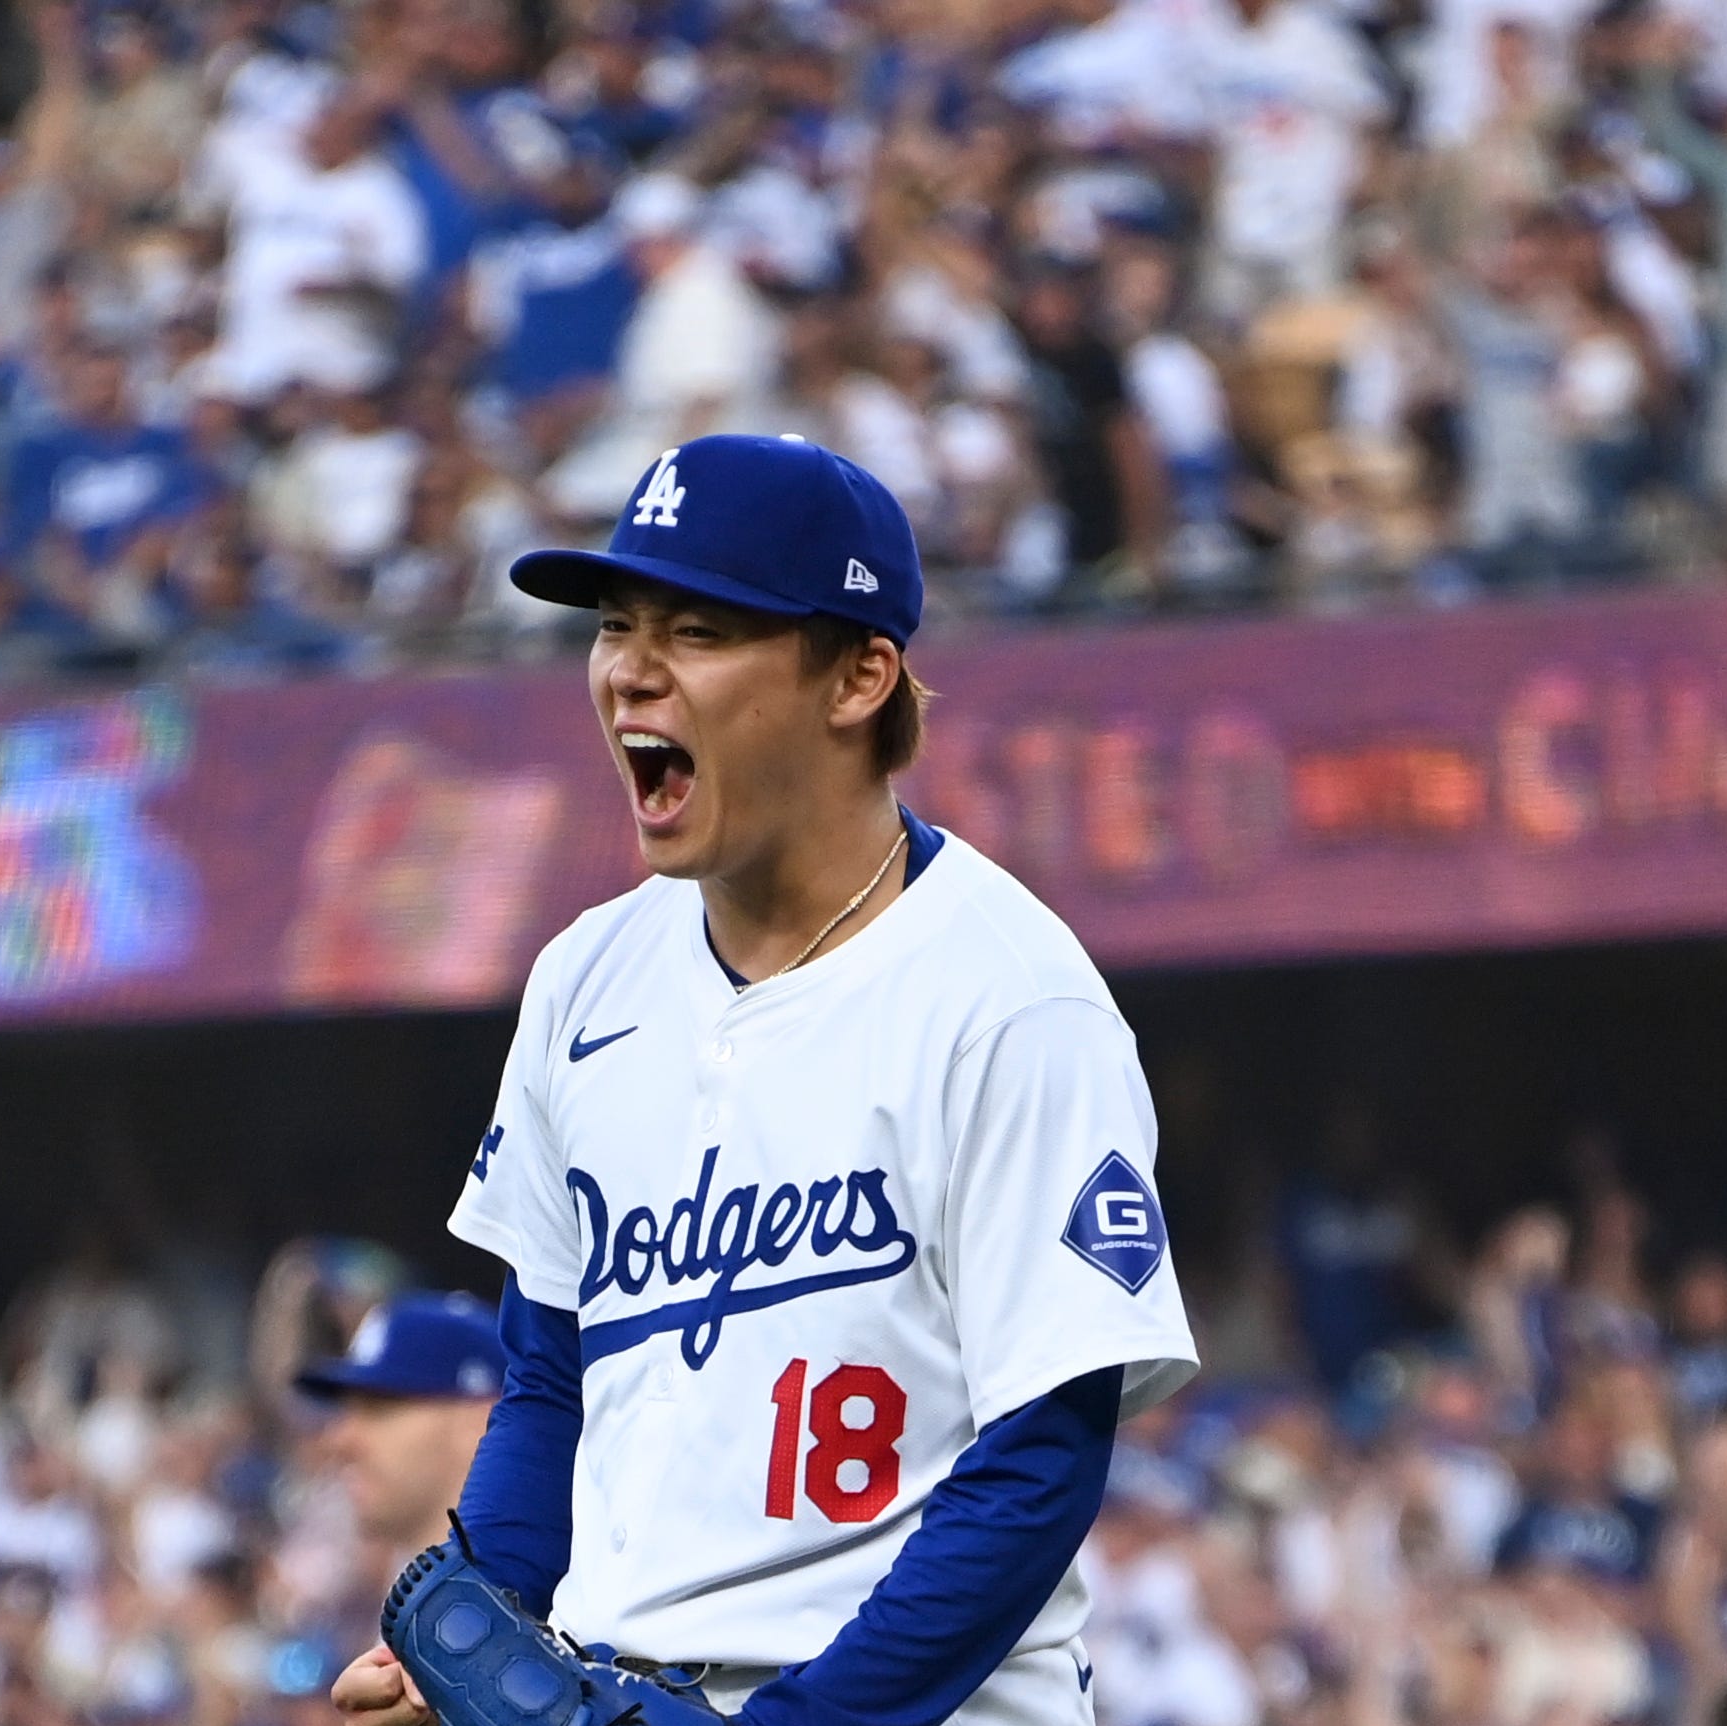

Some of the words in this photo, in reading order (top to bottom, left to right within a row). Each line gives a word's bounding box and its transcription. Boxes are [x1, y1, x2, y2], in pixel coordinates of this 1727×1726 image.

[632, 447, 686, 528] LA
[566, 1144, 917, 1371] Dodgers
[764, 1357, 908, 1524] 18
